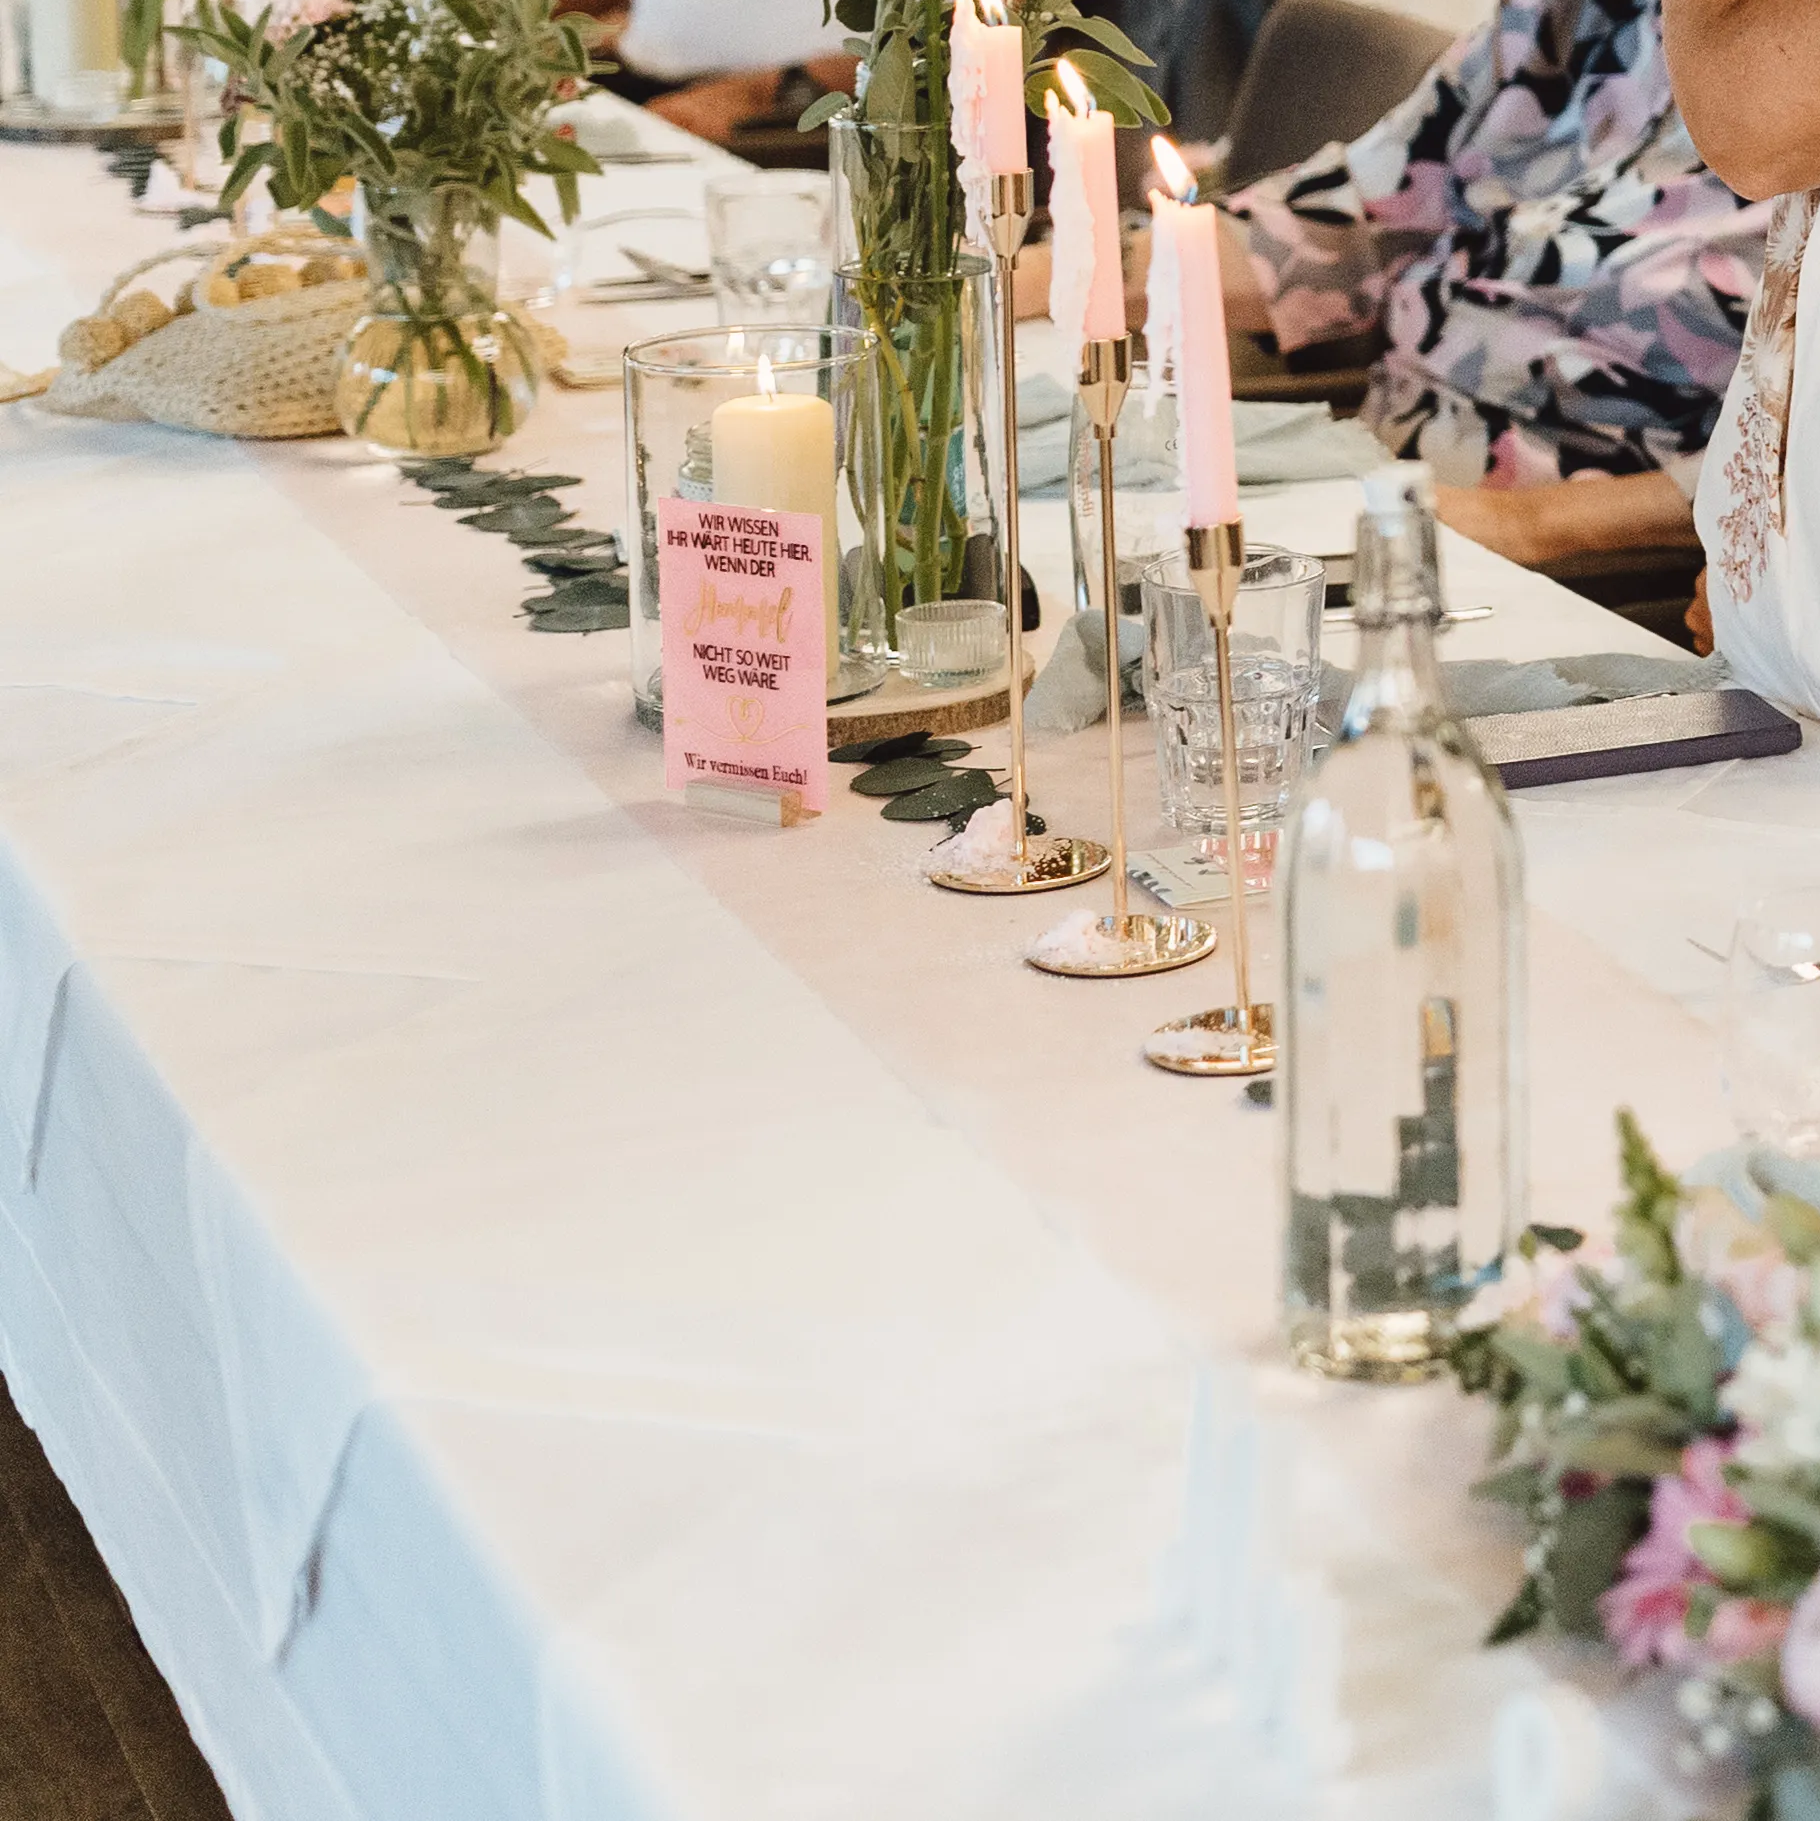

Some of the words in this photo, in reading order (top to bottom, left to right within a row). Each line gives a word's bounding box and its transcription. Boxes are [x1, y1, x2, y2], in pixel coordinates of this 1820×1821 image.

[698, 512, 725, 531] WIR
[727, 515, 780, 538] WISSEN
[667, 529, 688, 548] IHR
[690, 530, 730, 552] WÄRT
[732, 536, 778, 558] HEUTE
[704, 553, 748, 575] WENN
[750, 558, 776, 578] DER
[693, 643, 733, 663] NICHT
[736, 649, 754, 667] SO
[756, 651, 791, 672] WEIT
[703, 664, 736, 684] WEG
[684, 751, 707, 771] Wir
[709, 759, 769, 780] vermissen
[772, 764, 808, 786] Euch!
